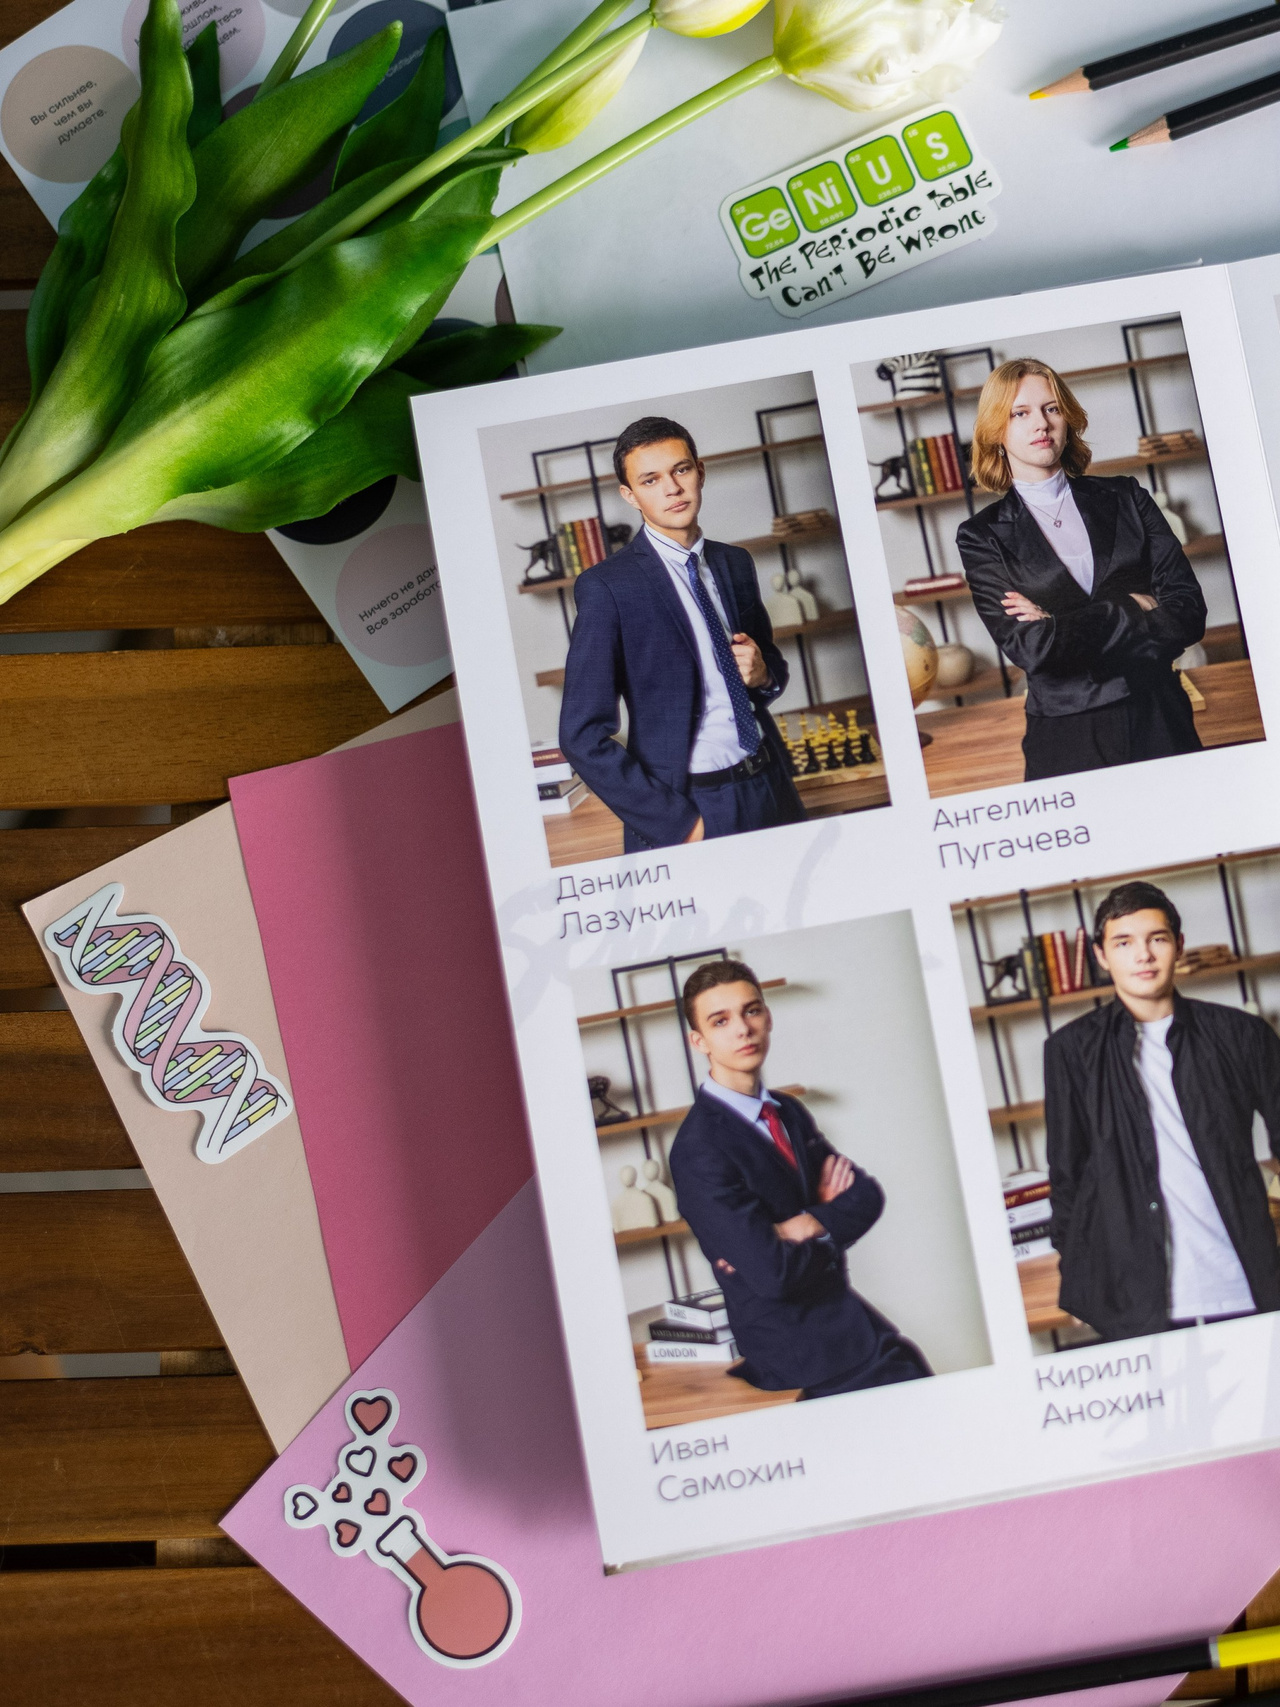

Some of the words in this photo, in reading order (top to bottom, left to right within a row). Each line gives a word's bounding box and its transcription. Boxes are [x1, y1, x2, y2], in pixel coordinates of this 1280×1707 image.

[30, 112, 47, 126] Вы
[48, 79, 97, 114] сильнее,
[54, 110, 77, 128] чем
[78, 99, 93, 114] вы
[57, 109, 108, 146] думаете.
[358, 591, 399, 622] Ничего
[400, 580, 414, 595] не
[365, 617, 389, 635] Все
[933, 791, 1076, 832] Ангелина
[939, 825, 1091, 869] Пугачева
[556, 864, 671, 904] Даниил
[559, 897, 697, 939] Лазукин
[653, 1347, 698, 1358] LONDON
[1036, 1353, 1152, 1391] Кирилл
[1041, 1388, 1166, 1430] Анохин
[650, 1434, 729, 1465] Иван
[656, 1456, 806, 1502] Самохин
